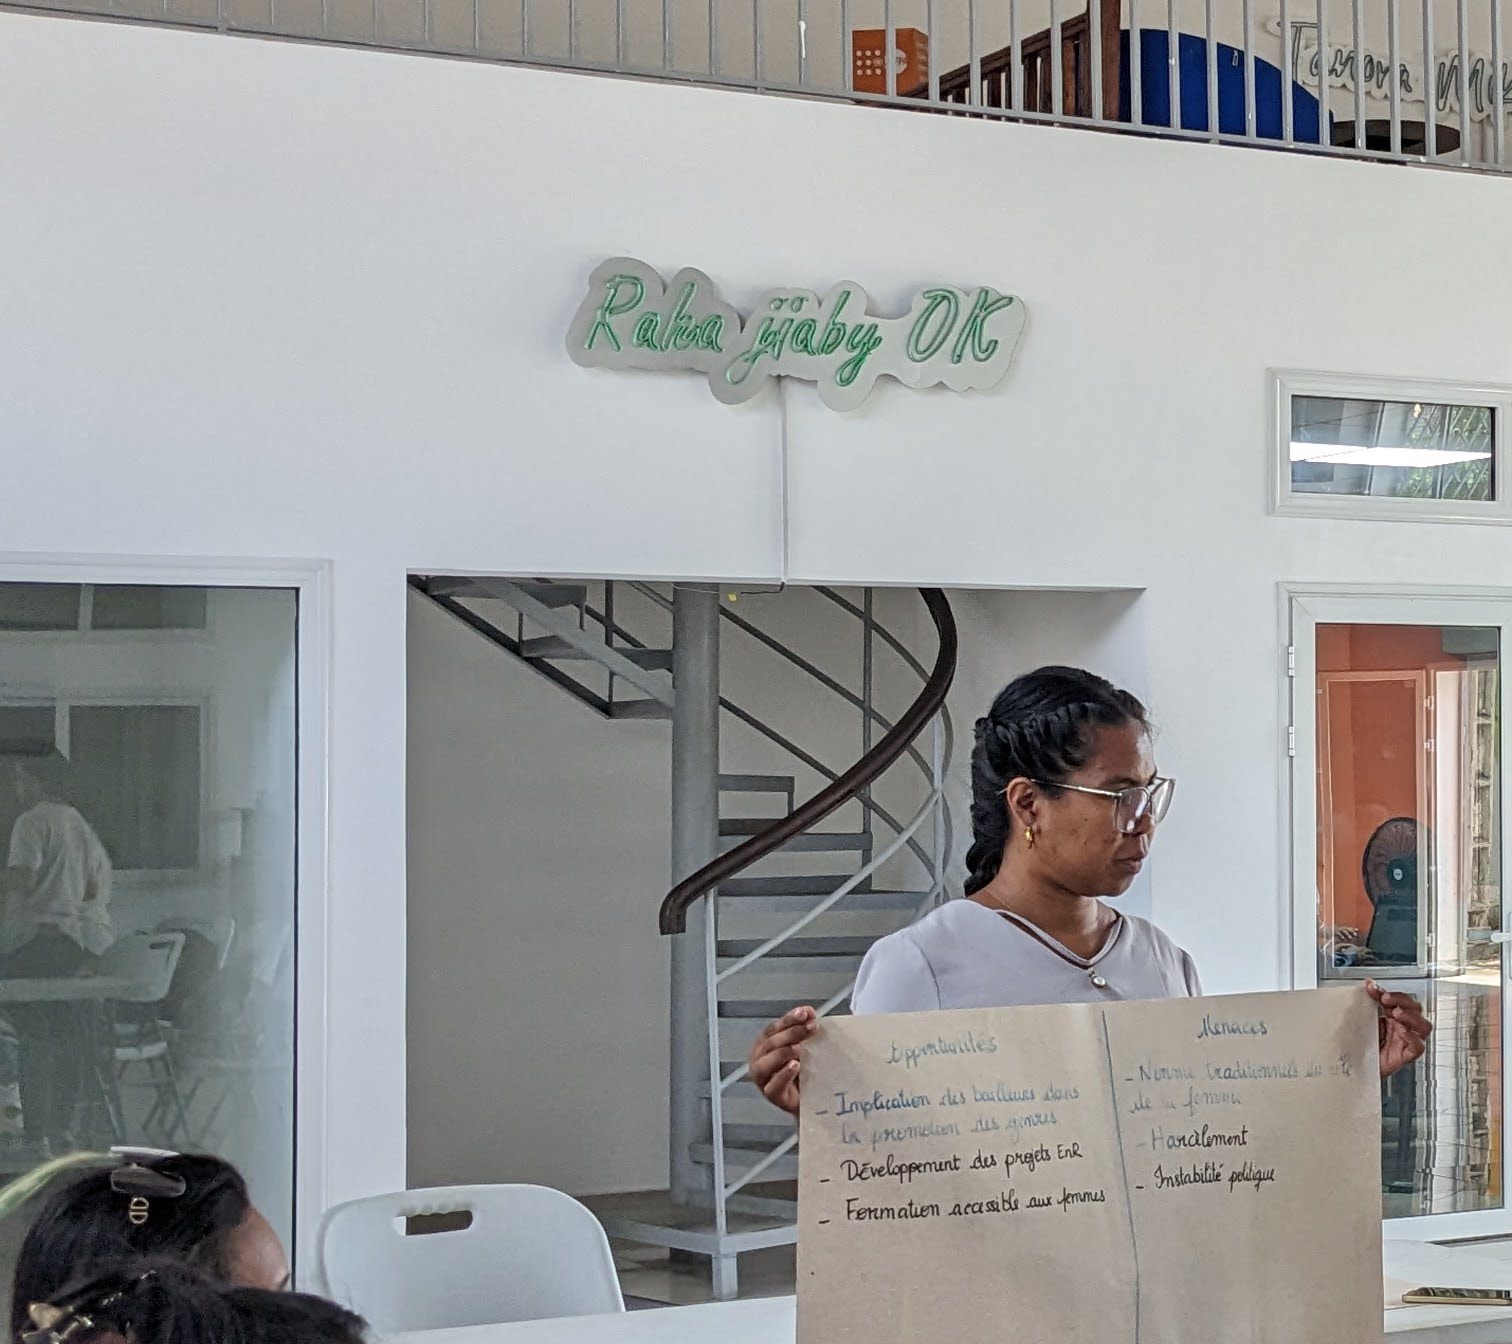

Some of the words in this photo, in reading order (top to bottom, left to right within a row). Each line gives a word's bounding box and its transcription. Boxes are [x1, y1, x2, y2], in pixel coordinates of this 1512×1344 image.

[584, 274, 724, 353] Raha
[908, 288, 1013, 365] OK
[1197, 1013, 1269, 1040] Menaces
[834, 1090, 931, 1120] Implication
[939, 1086, 967, 1107] des
[1042, 1083, 1080, 1102] dans
[971, 1114, 1000, 1134] des
[970, 1148, 998, 1170] des
[1004, 1142, 1051, 1178] projets
[1057, 1141, 1084, 1160] EnR
[1153, 1161, 1224, 1190] Instabilité
[1229, 1160, 1276, 1194] politique
[846, 1197, 940, 1223] Formation
[1025, 1195, 1053, 1210] aux
[1057, 1187, 1107, 1213] femmes
